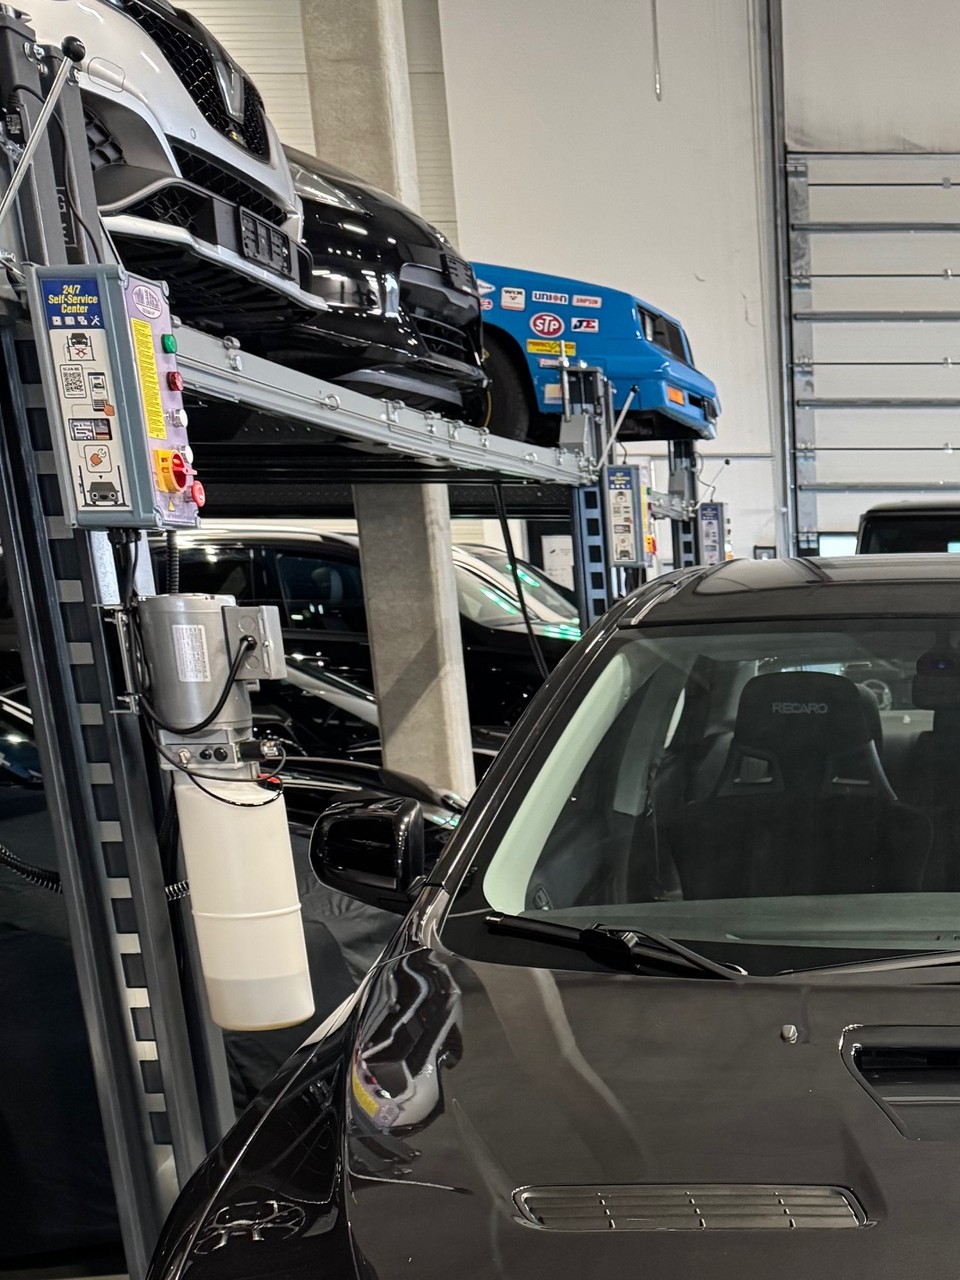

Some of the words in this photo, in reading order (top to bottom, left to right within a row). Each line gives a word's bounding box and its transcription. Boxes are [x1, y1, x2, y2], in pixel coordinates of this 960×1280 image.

[62, 284, 81, 295] 24/7
[48, 294, 98, 304] Self-Service
[61, 303, 89, 314] Center
[535, 315, 560, 333] STP
[772, 702, 828, 714] RECARO
